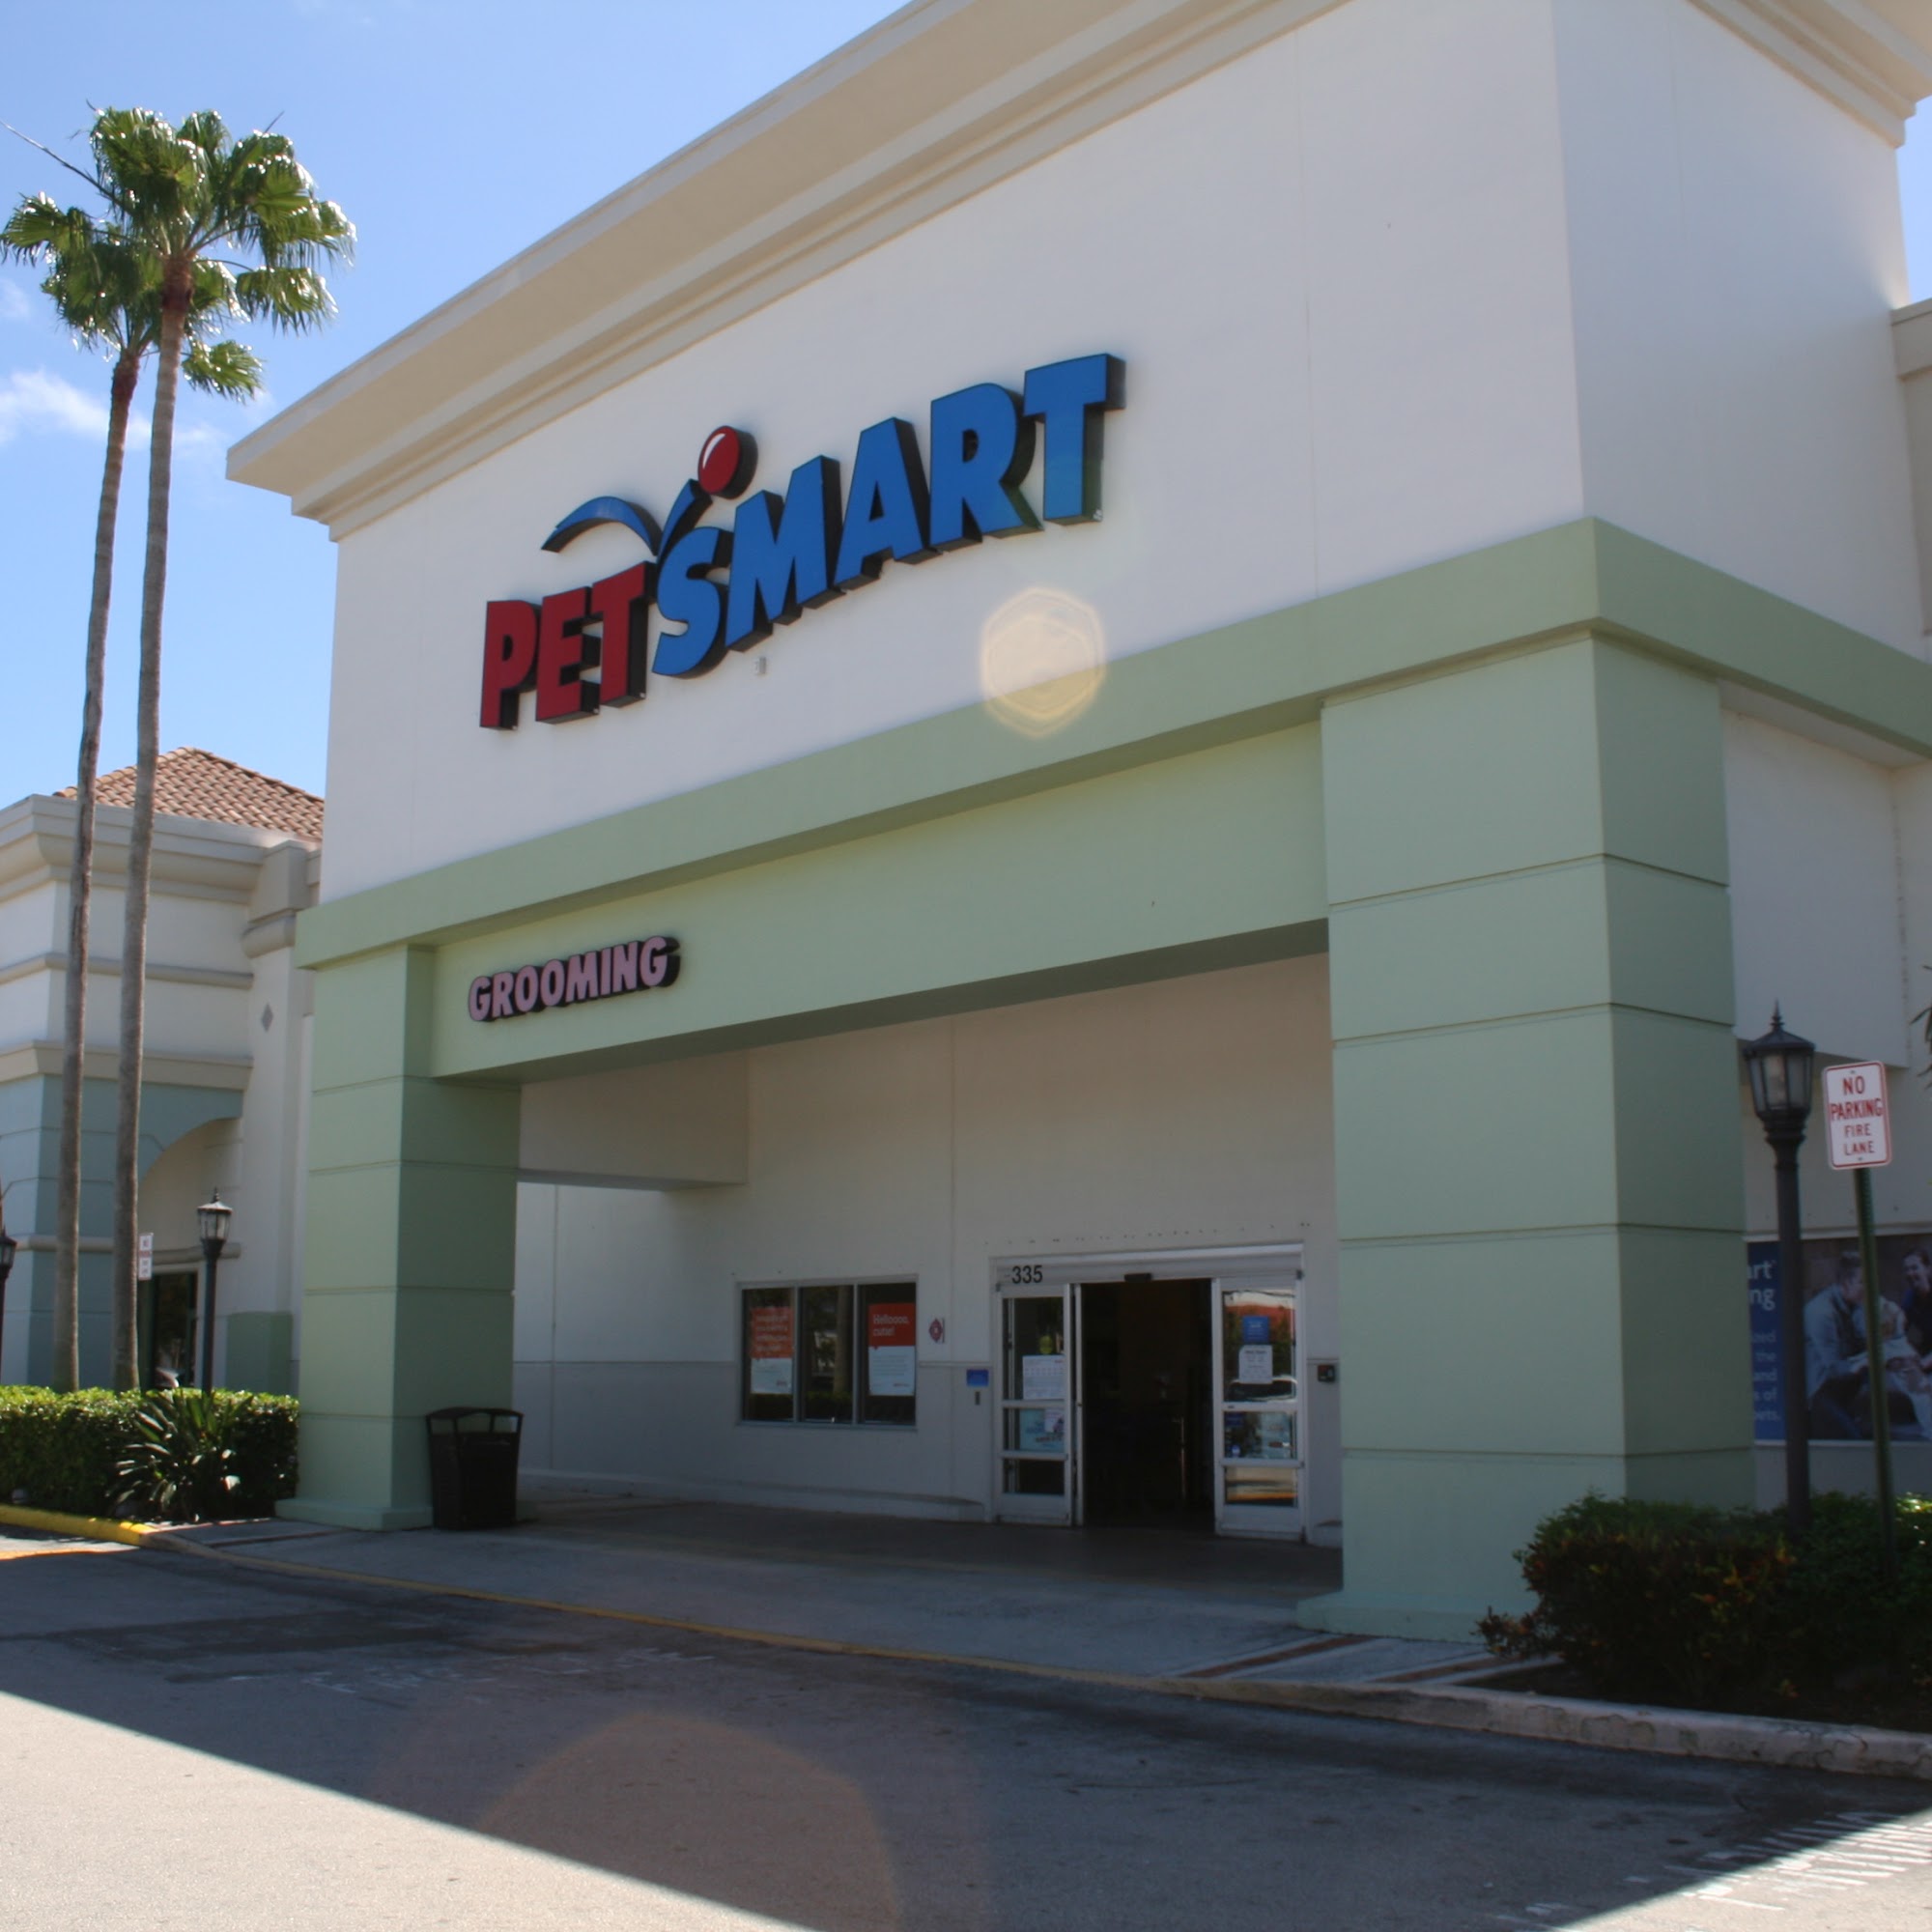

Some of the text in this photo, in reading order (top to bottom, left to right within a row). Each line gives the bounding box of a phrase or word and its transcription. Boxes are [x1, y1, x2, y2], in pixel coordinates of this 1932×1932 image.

[479, 353, 1126, 730] PETSMART
[469, 935, 680, 1022] GROOMING
[1842, 1075, 1865, 1095] NO
[1830, 1098, 1884, 1121] PARKING
[1844, 1122, 1872, 1138] FIRE
[1844, 1141, 1876, 1156] LANE
[1011, 1264, 1043, 1284] 335
